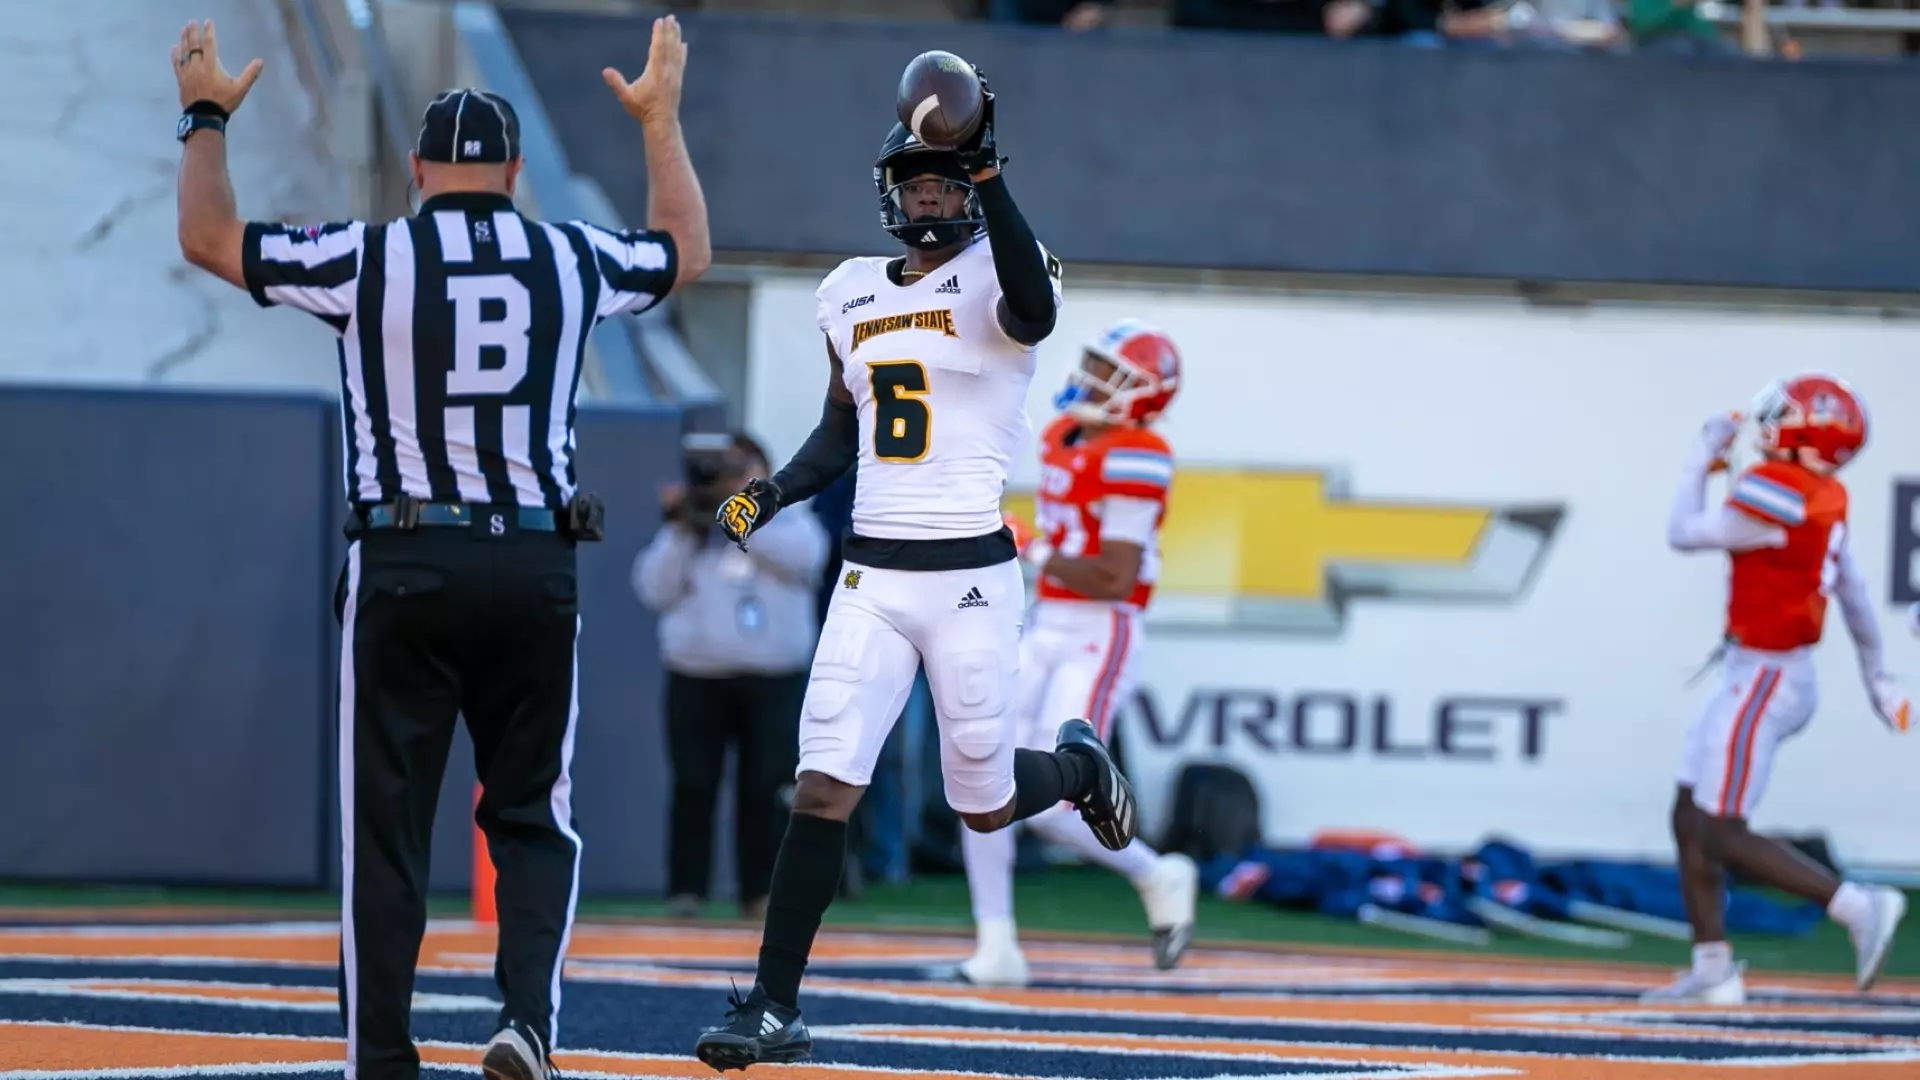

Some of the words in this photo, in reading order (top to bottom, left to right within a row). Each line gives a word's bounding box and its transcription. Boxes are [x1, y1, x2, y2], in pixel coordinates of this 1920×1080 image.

[463, 140, 482, 157] RR
[446, 273, 532, 395] B
[850, 313, 914, 353] KENNESAW
[914, 308, 960, 339] STATE
[865, 359, 933, 464] 6
[489, 513, 506, 536] S
[957, 599, 989, 610] adidas
[1133, 687, 1568, 762] VROLET
